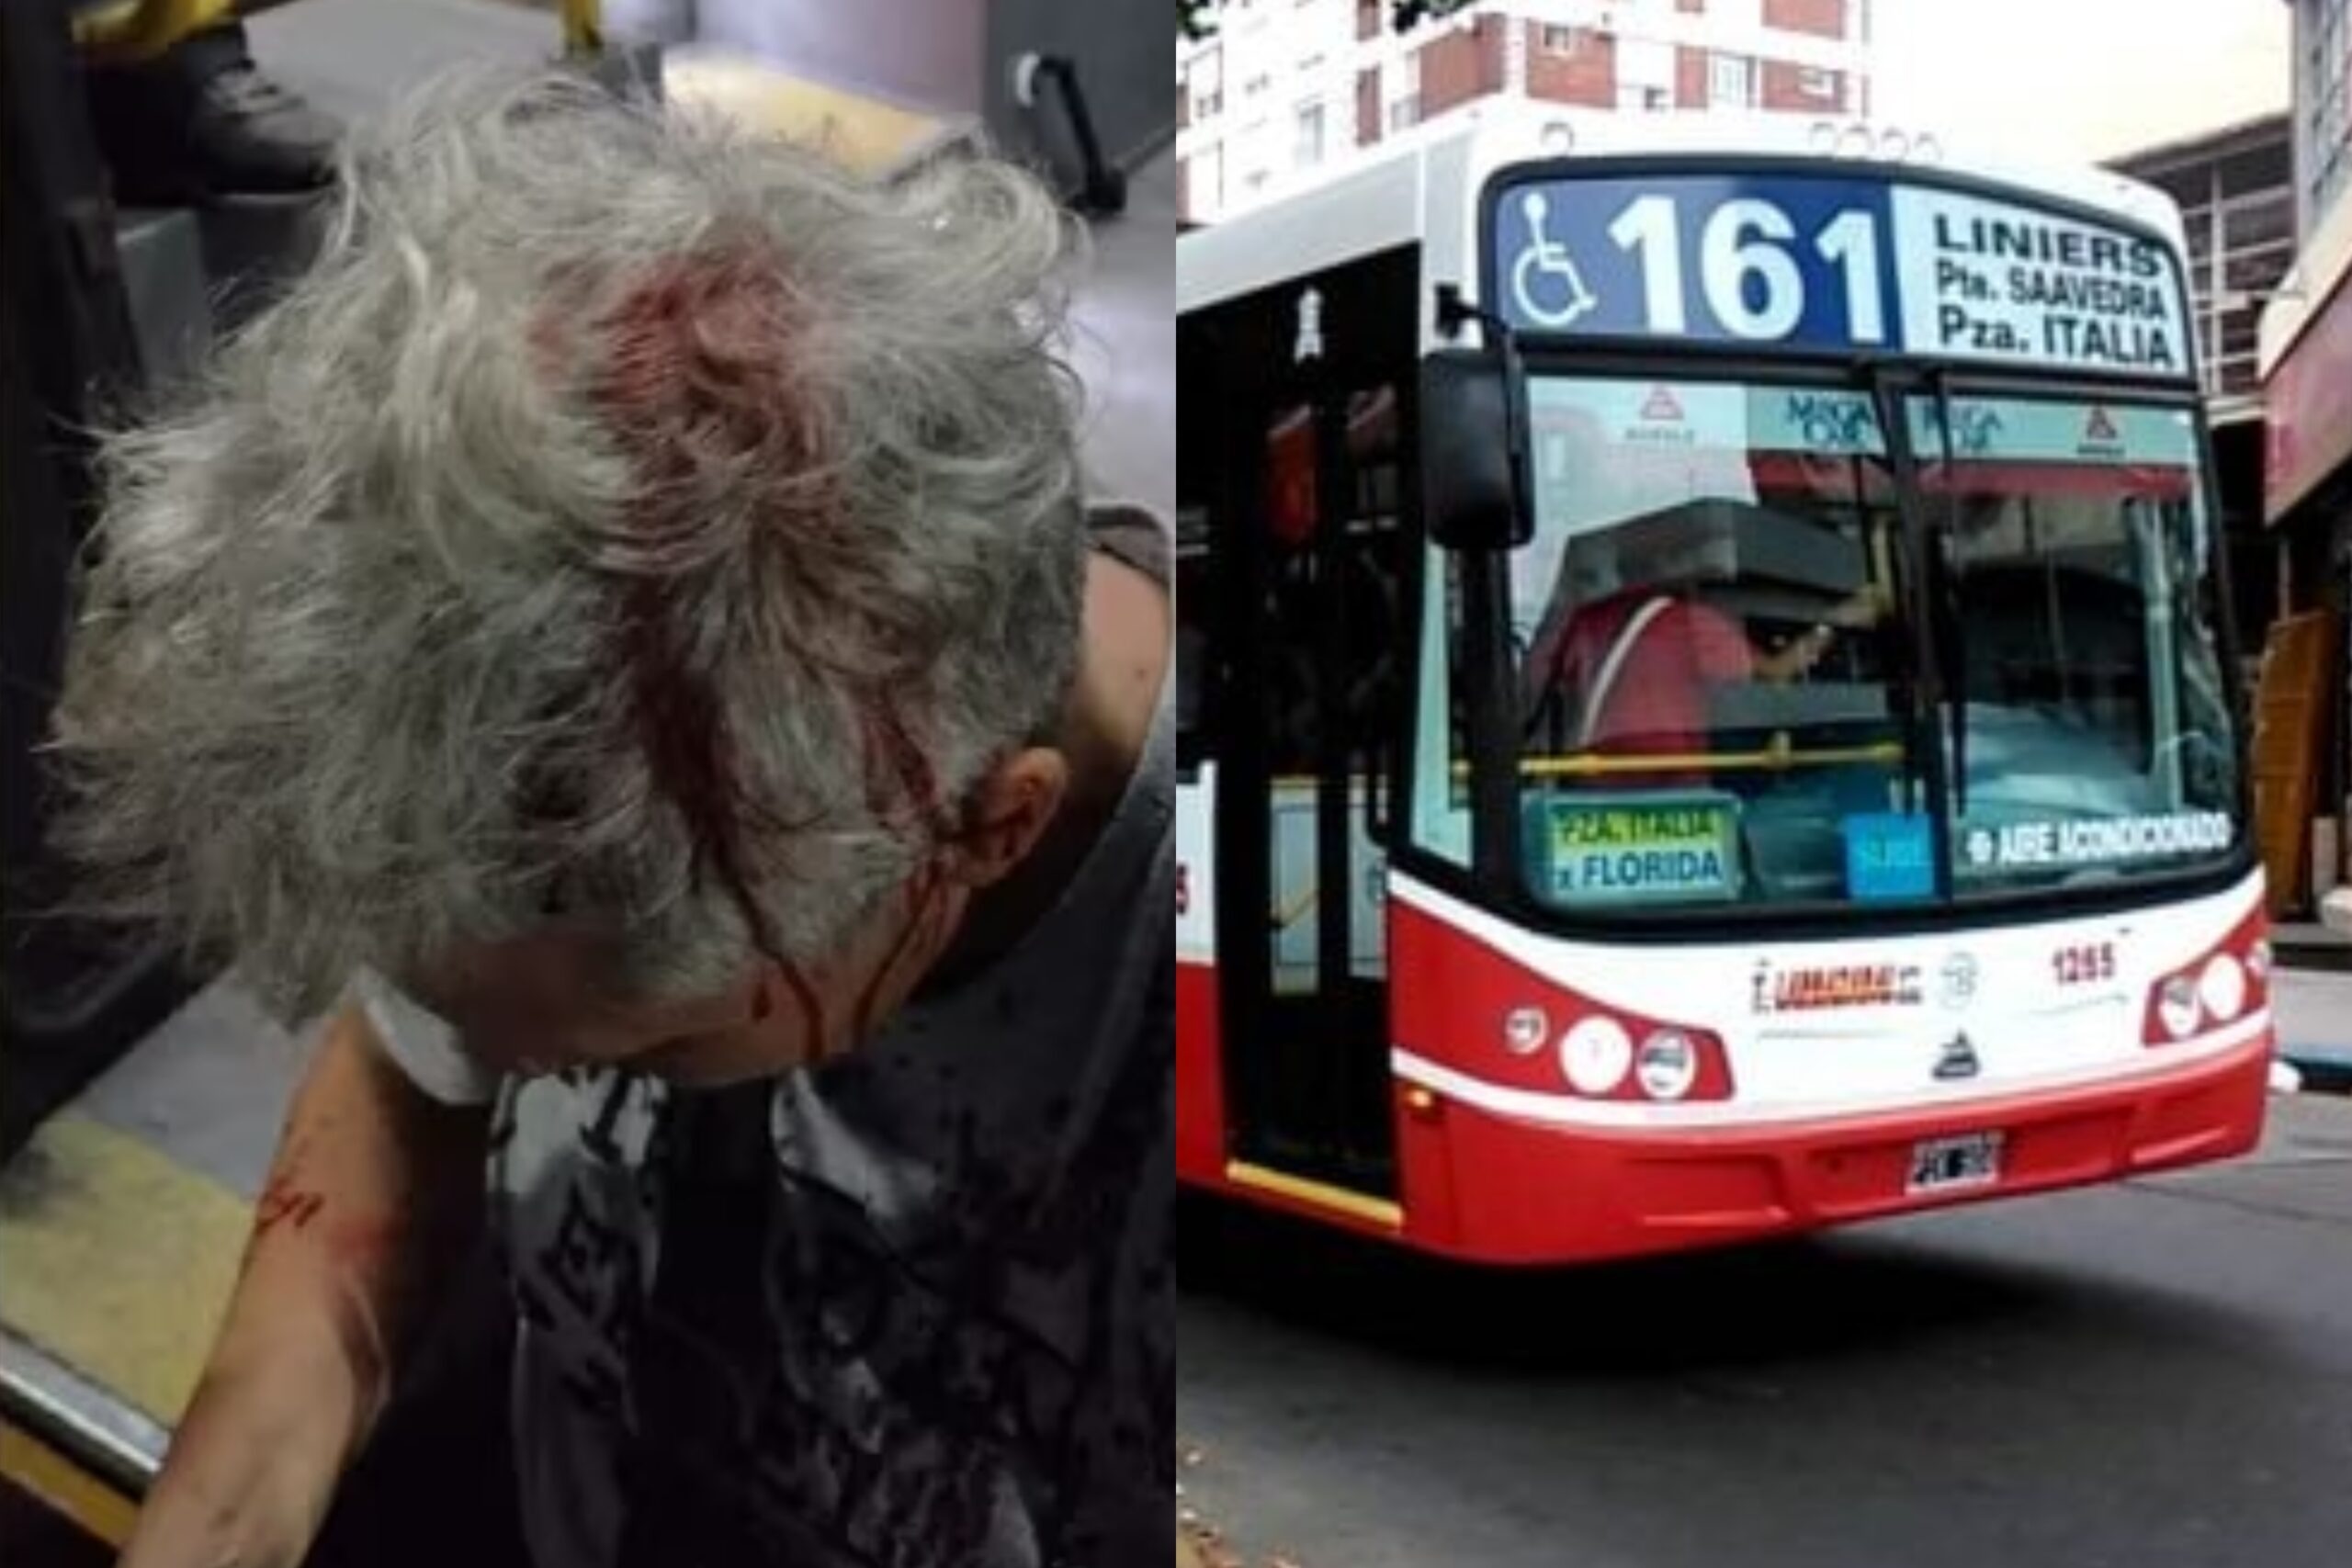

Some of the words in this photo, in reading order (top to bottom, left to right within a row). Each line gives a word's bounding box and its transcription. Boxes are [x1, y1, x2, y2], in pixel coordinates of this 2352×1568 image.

[1608, 193, 1885, 344] 161
[1934, 212, 2165, 276] LINIERS
[2008, 267, 2168, 320] SAAVEDRA
[1938, 303, 2030, 353] Pza.
[2043, 313, 2174, 366] ITALIA
[1623, 804, 1714, 842] ITALIA
[1999, 820, 2056, 863] AIRE
[1583, 849, 1722, 886] FLORIDA
